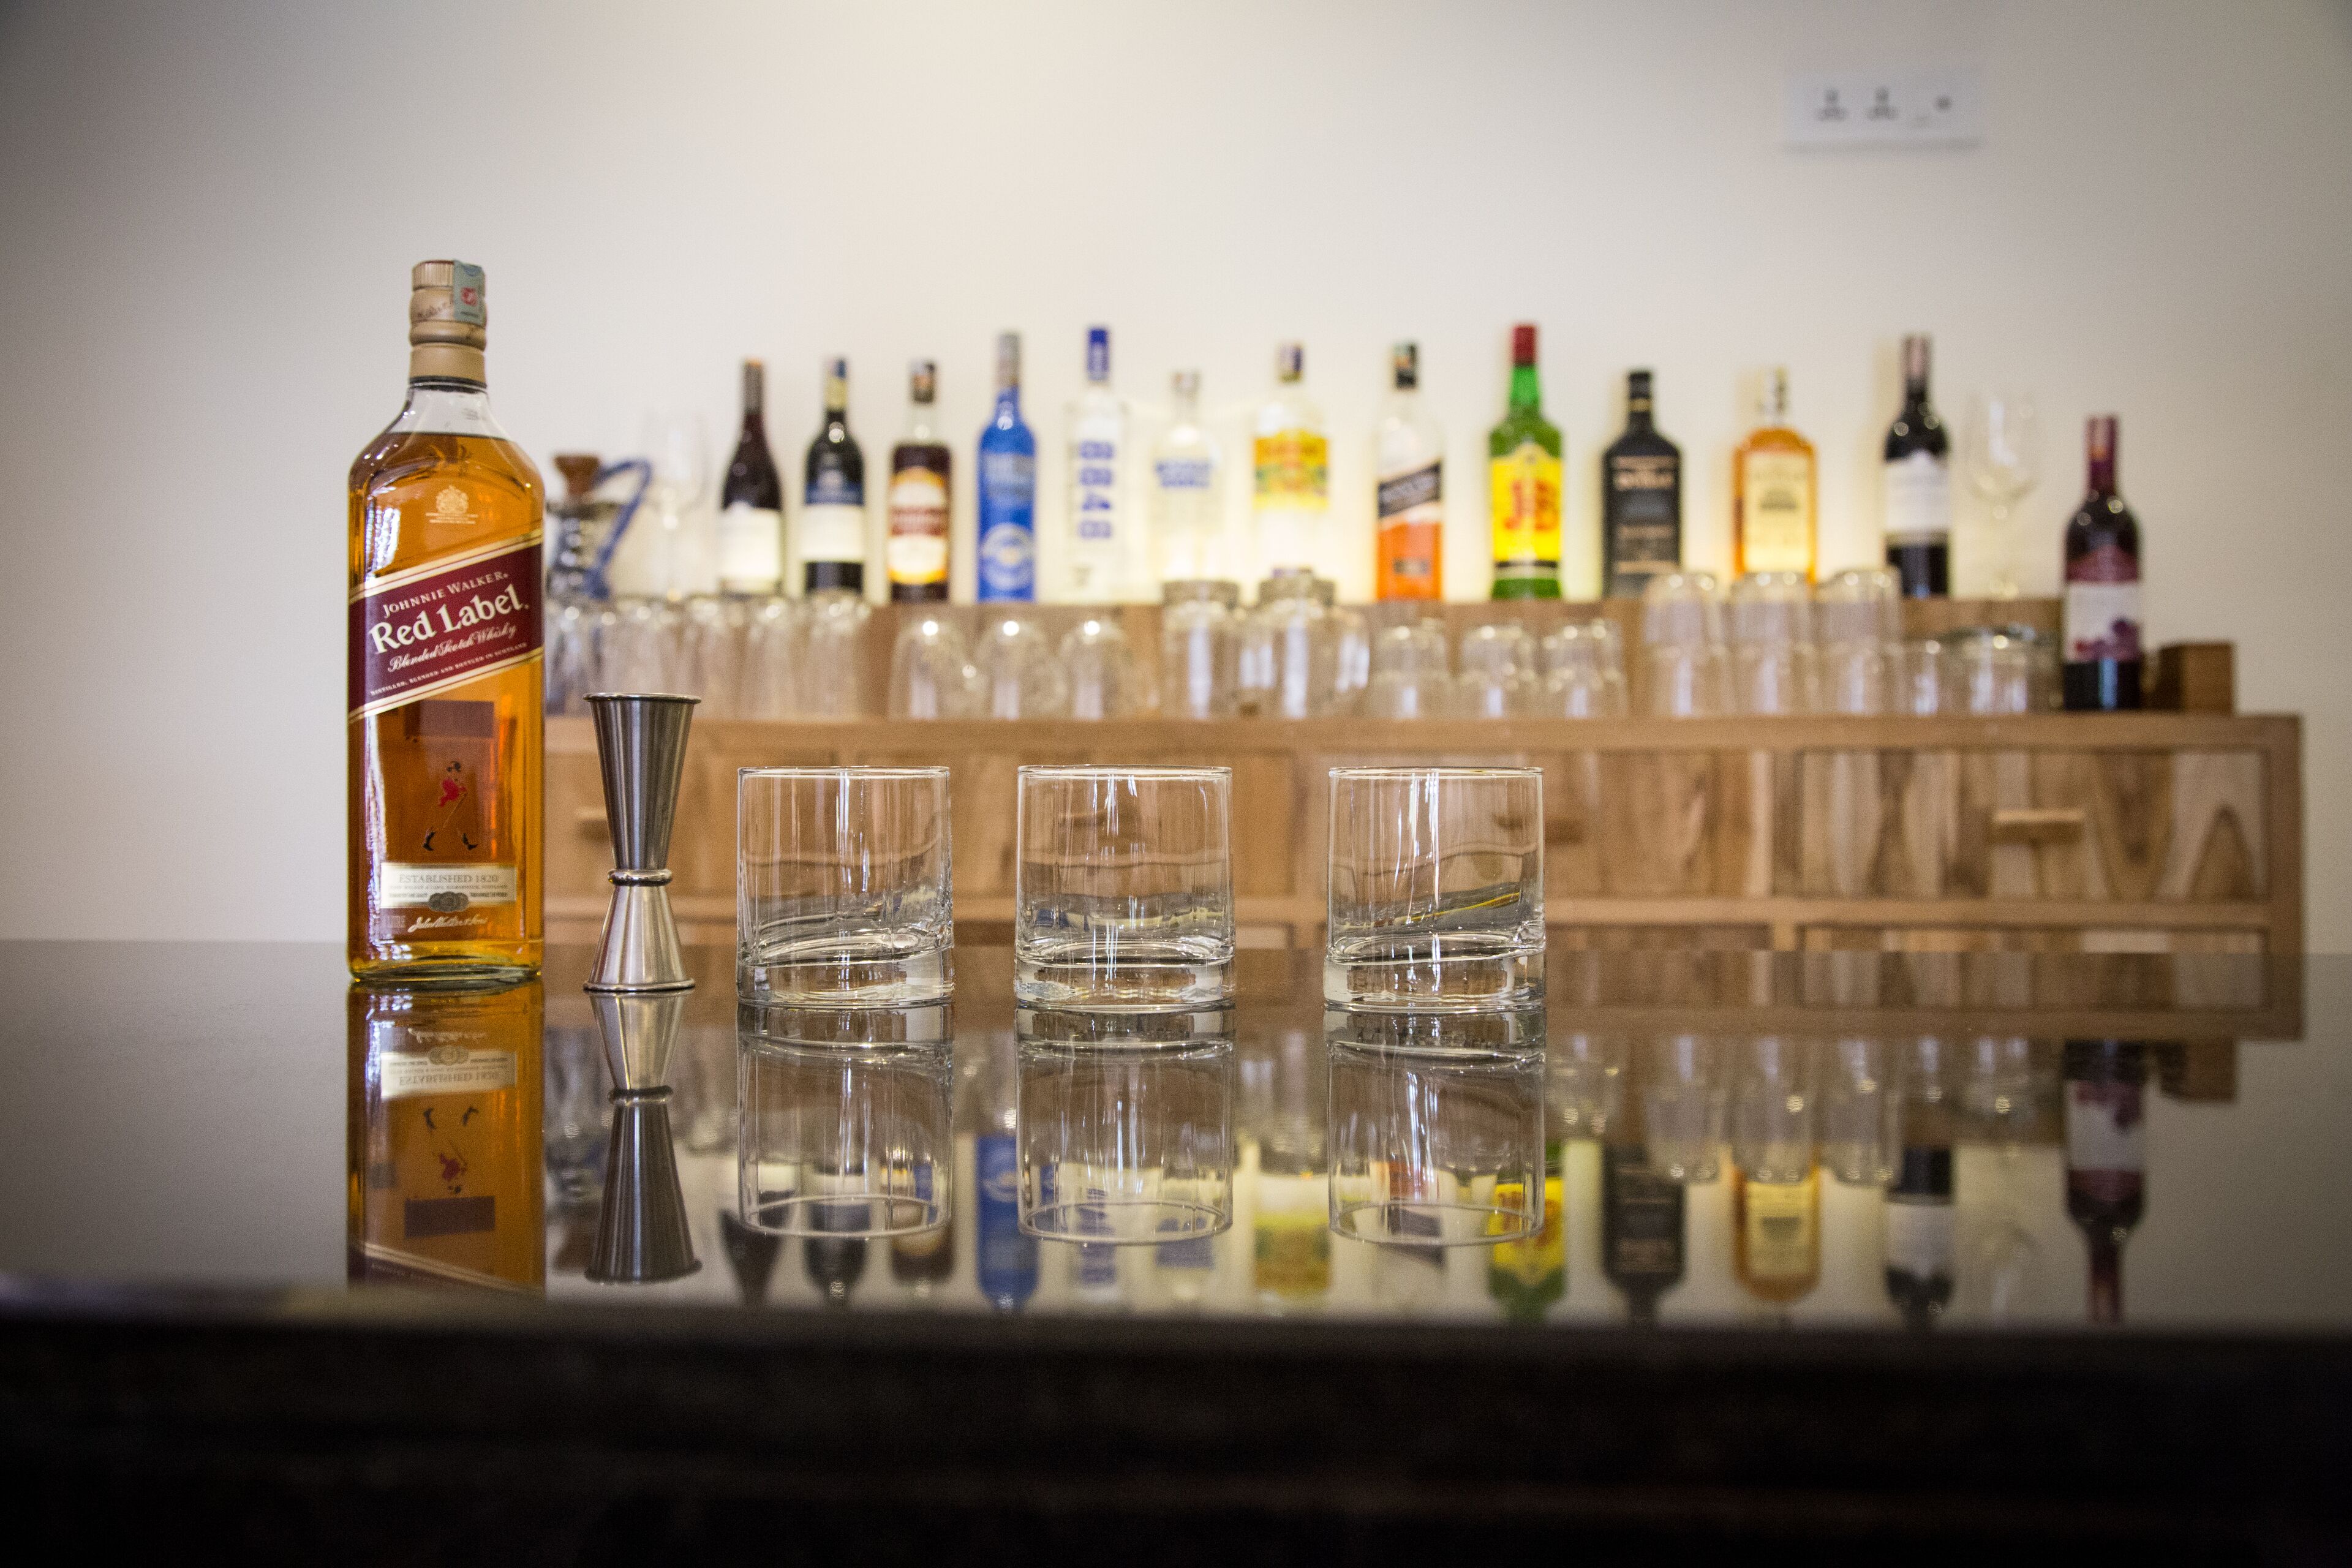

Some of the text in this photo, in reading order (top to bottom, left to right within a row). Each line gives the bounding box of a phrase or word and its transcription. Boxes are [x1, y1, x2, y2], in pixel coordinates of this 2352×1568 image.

[383, 589, 445, 619] JOHNNIE
[368, 609, 437, 655] Red
[388, 621, 517, 673] Blended Scotch Whisky
[399, 874, 499, 883] ESTABLISHED 1820
